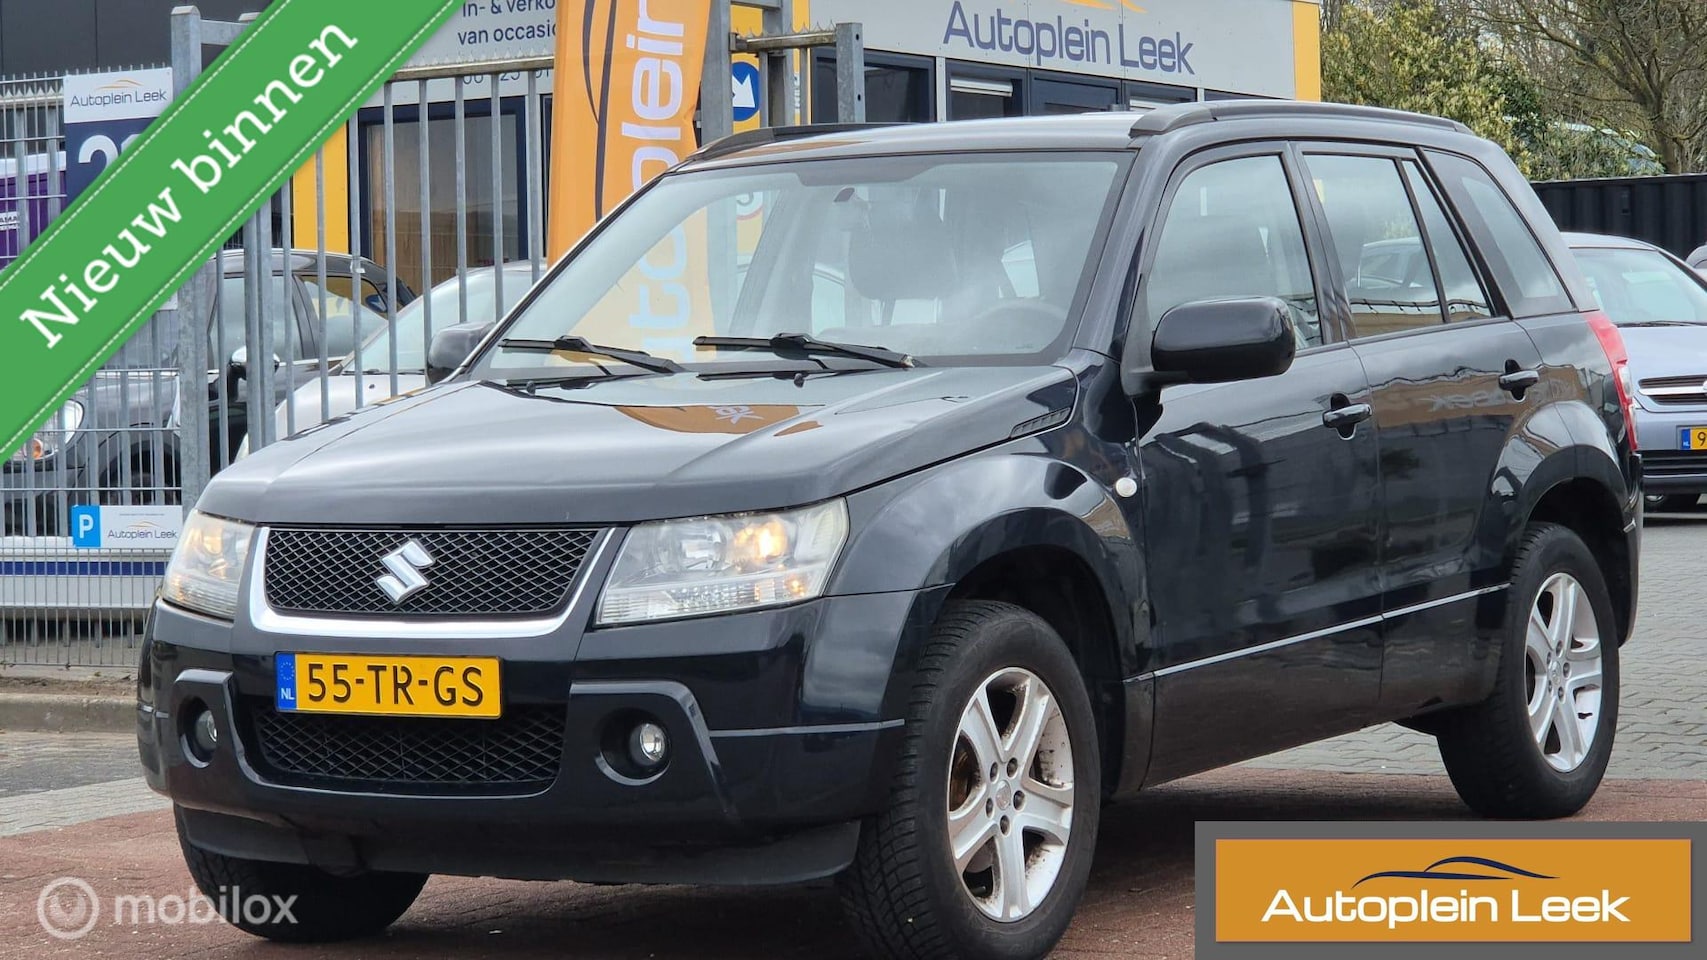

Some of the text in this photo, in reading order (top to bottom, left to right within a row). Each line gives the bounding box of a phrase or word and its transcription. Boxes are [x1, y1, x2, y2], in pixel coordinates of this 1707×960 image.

[457, 29, 489, 45] van
[943, 0, 1195, 75] Autoplein Leek
[70, 88, 167, 107] Autoplein Leek
[79, 514, 94, 539] P
[108, 529, 178, 540] Autoplein Leek
[281, 688, 295, 700] NL
[308, 663, 484, 707] 55-TR-GS
